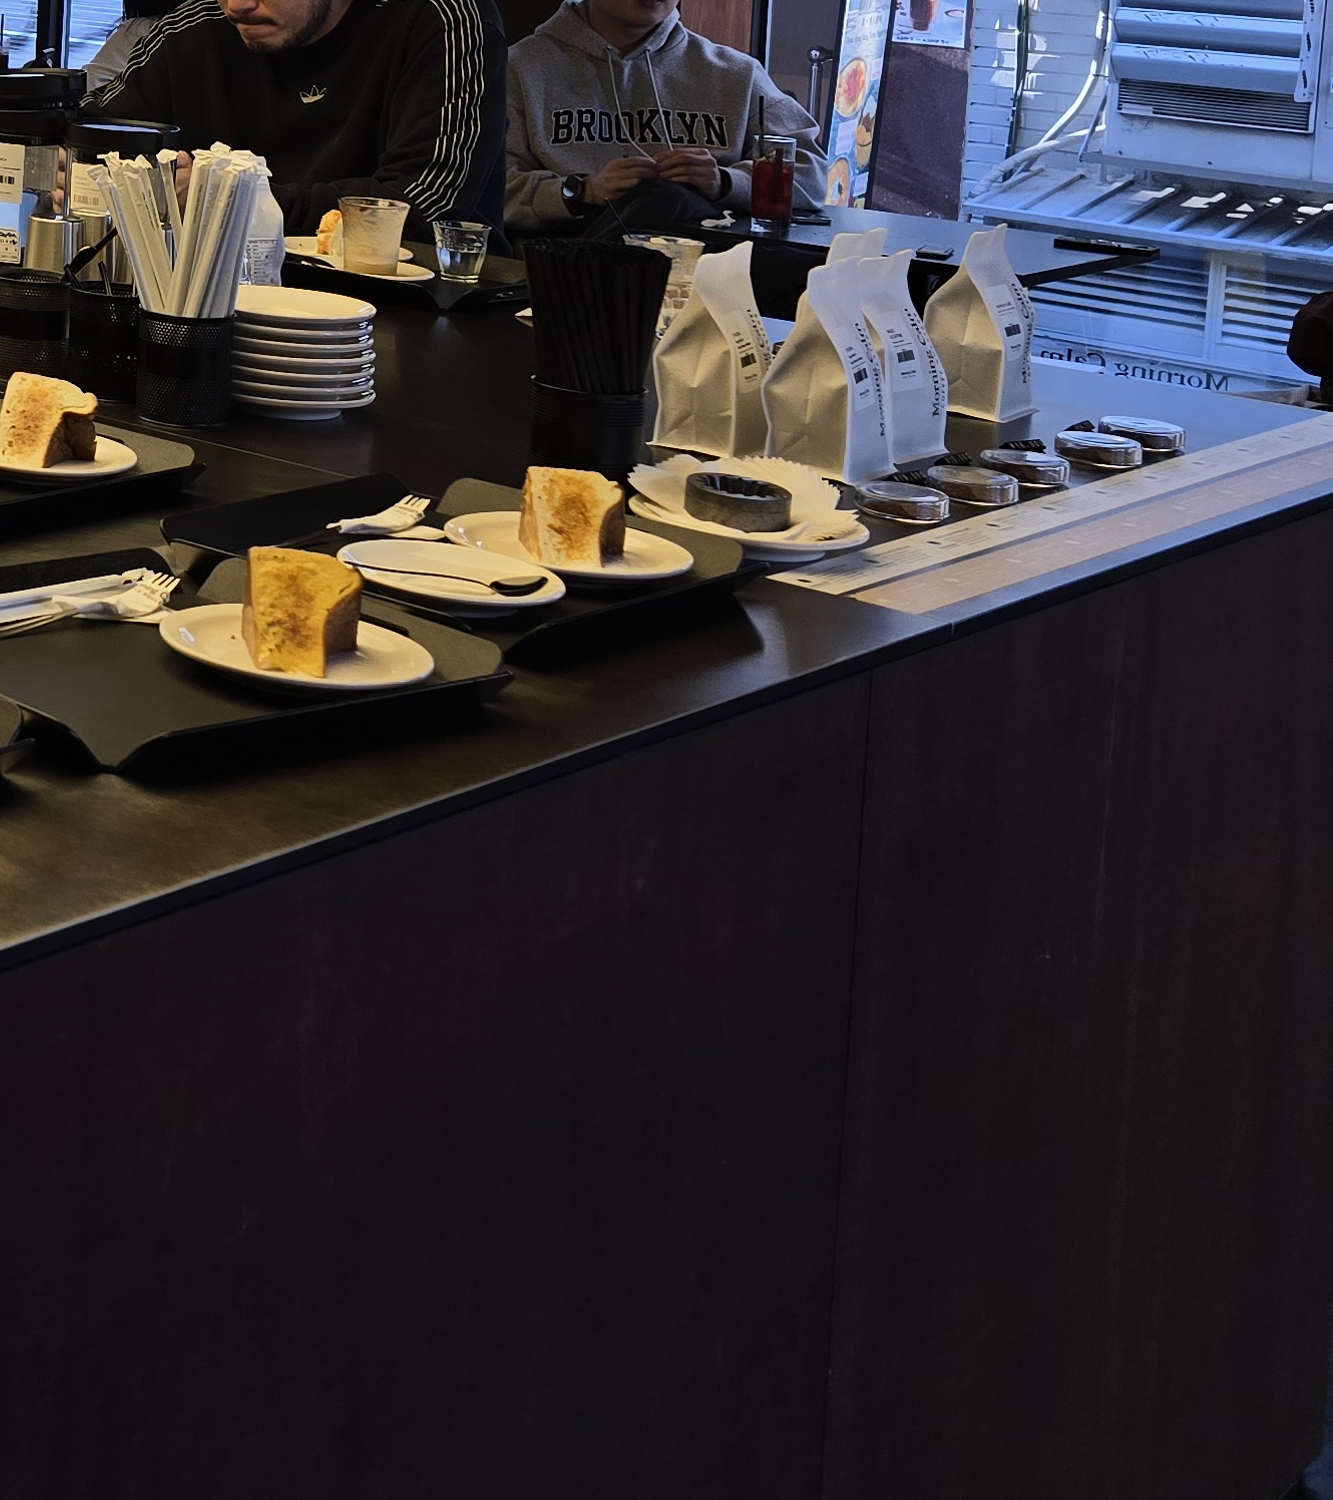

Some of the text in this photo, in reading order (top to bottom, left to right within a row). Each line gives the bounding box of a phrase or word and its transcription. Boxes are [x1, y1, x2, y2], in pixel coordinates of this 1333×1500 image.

[550, 107, 729, 149] BROOKLYN
[904, 308, 940, 417] Morning Calm
